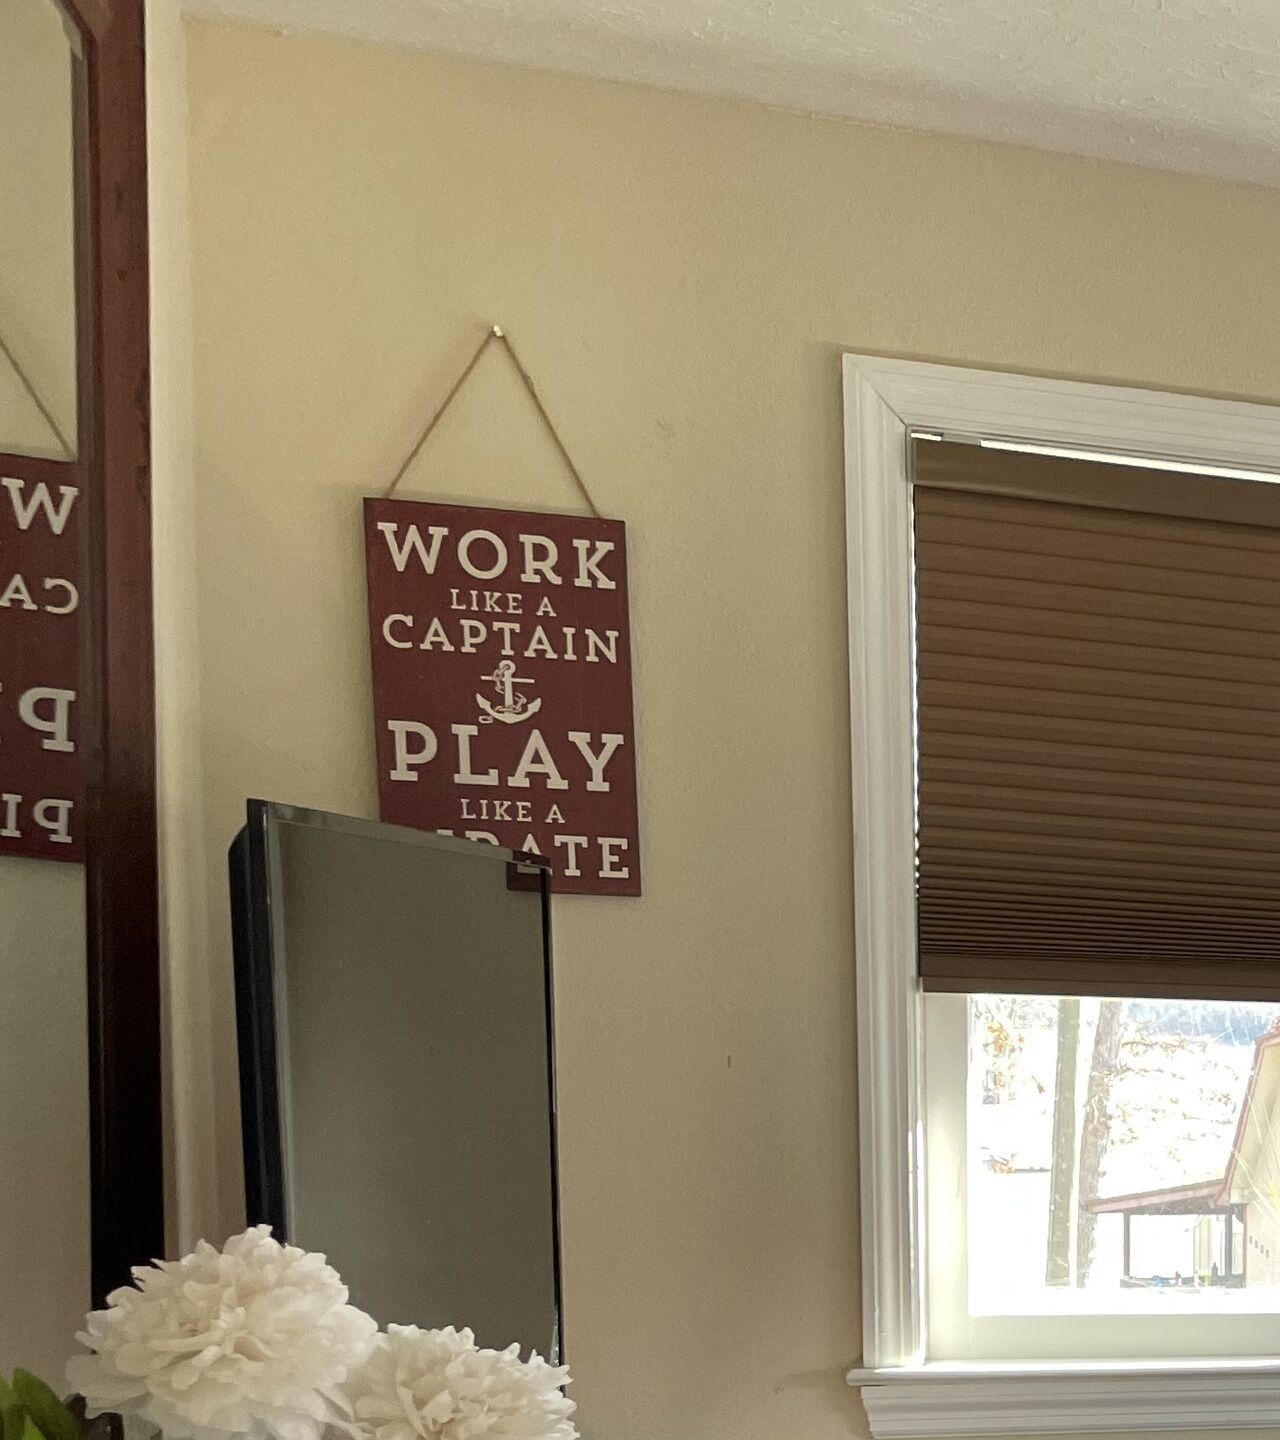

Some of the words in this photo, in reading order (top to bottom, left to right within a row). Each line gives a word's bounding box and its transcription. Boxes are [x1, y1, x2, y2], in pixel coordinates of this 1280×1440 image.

[377, 522, 617, 590] WORK
[450, 588, 524, 616] LIKE
[535, 596, 557, 618] A
[382, 613, 620, 664] CAPTAIN
[387, 719, 625, 792] PLAY
[460, 798, 533, 823] LIKE
[544, 803, 566, 825] A
